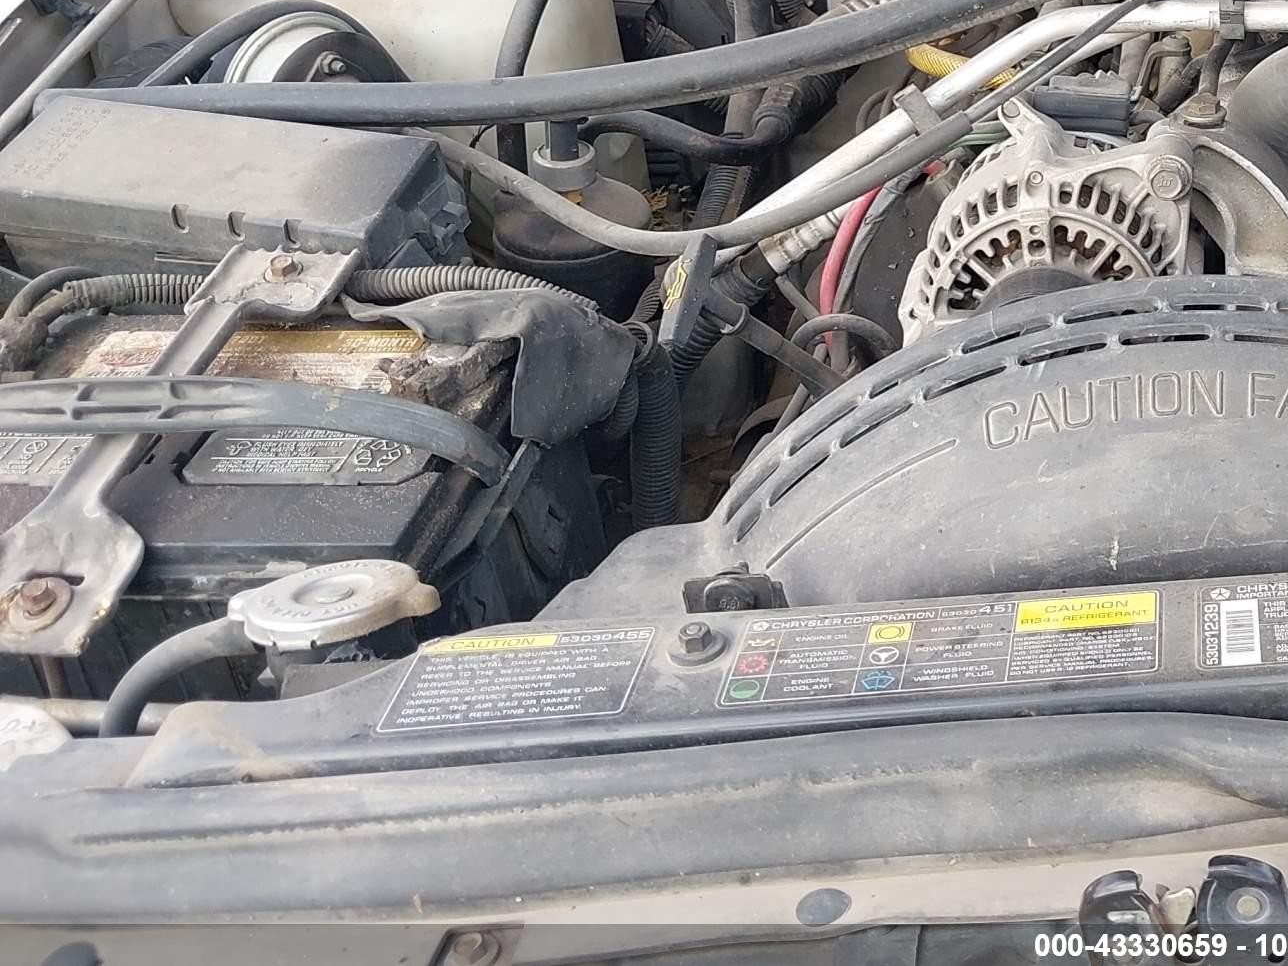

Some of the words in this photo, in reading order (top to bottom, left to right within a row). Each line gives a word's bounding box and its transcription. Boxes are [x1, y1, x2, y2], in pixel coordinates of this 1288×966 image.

[342, 337, 418, 348] 30-MONTH
[983, 370, 1225, 450] CAUTION
[1045, 599, 1129, 614] CAUTION
[771, 618, 842, 629] CHRYSLER
[843, 611, 936, 625] CORPORATION
[1062, 609, 1148, 622] REFRIGERANT
[965, 622, 993, 630] FLUID
[795, 634, 832, 642] ENGINE
[1204, 603, 1219, 665] 53031239
[450, 637, 535, 650] CAUTION
[915, 644, 953, 652] POWER
[954, 641, 1004, 650] STEERING
[431, 656, 453, 664] THIS
[458, 653, 498, 662] VEHICLE
[518, 649, 567, 658] EQUIPPED
[571, 647, 598, 655] WITH
[779, 654, 857, 665] TRANSMISSION
[789, 649, 849, 658] AUTOMATIC
[420, 672, 454, 680] REFER
[500, 666, 542, 675] SERVICE
[545, 663, 589, 672] MANUAL
[593, 660, 632, 668] BEFORE
[426, 661, 503, 672] SUPPLEMENTAL
[511, 659, 546, 667] DRIVER
[923, 664, 989, 674] WINDSHIELD
[416, 679, 470, 689] SERVICING
[494, 672, 577, 684] DISASSEMBLING
[791, 676, 830, 685] ENGINE
[913, 673, 959, 682] WASHER
[965, 670, 994, 678] FLUID
[412, 687, 476, 697] UNDERHOOD
[480, 681, 552, 693] COMPONENTS
[783, 683, 834, 692] COOLANT
[406, 695, 460, 707] IMPROPER
[464, 693, 508, 702] SERVICE
[511, 687, 582, 697] PROCEDURES
[401, 706, 441, 715] DEPLOY
[497, 700, 518, 708] BAG
[540, 696, 571, 704] MAKE
[396, 713, 461, 724] INOPERATIVE
[468, 708, 526, 719] RESULTING
